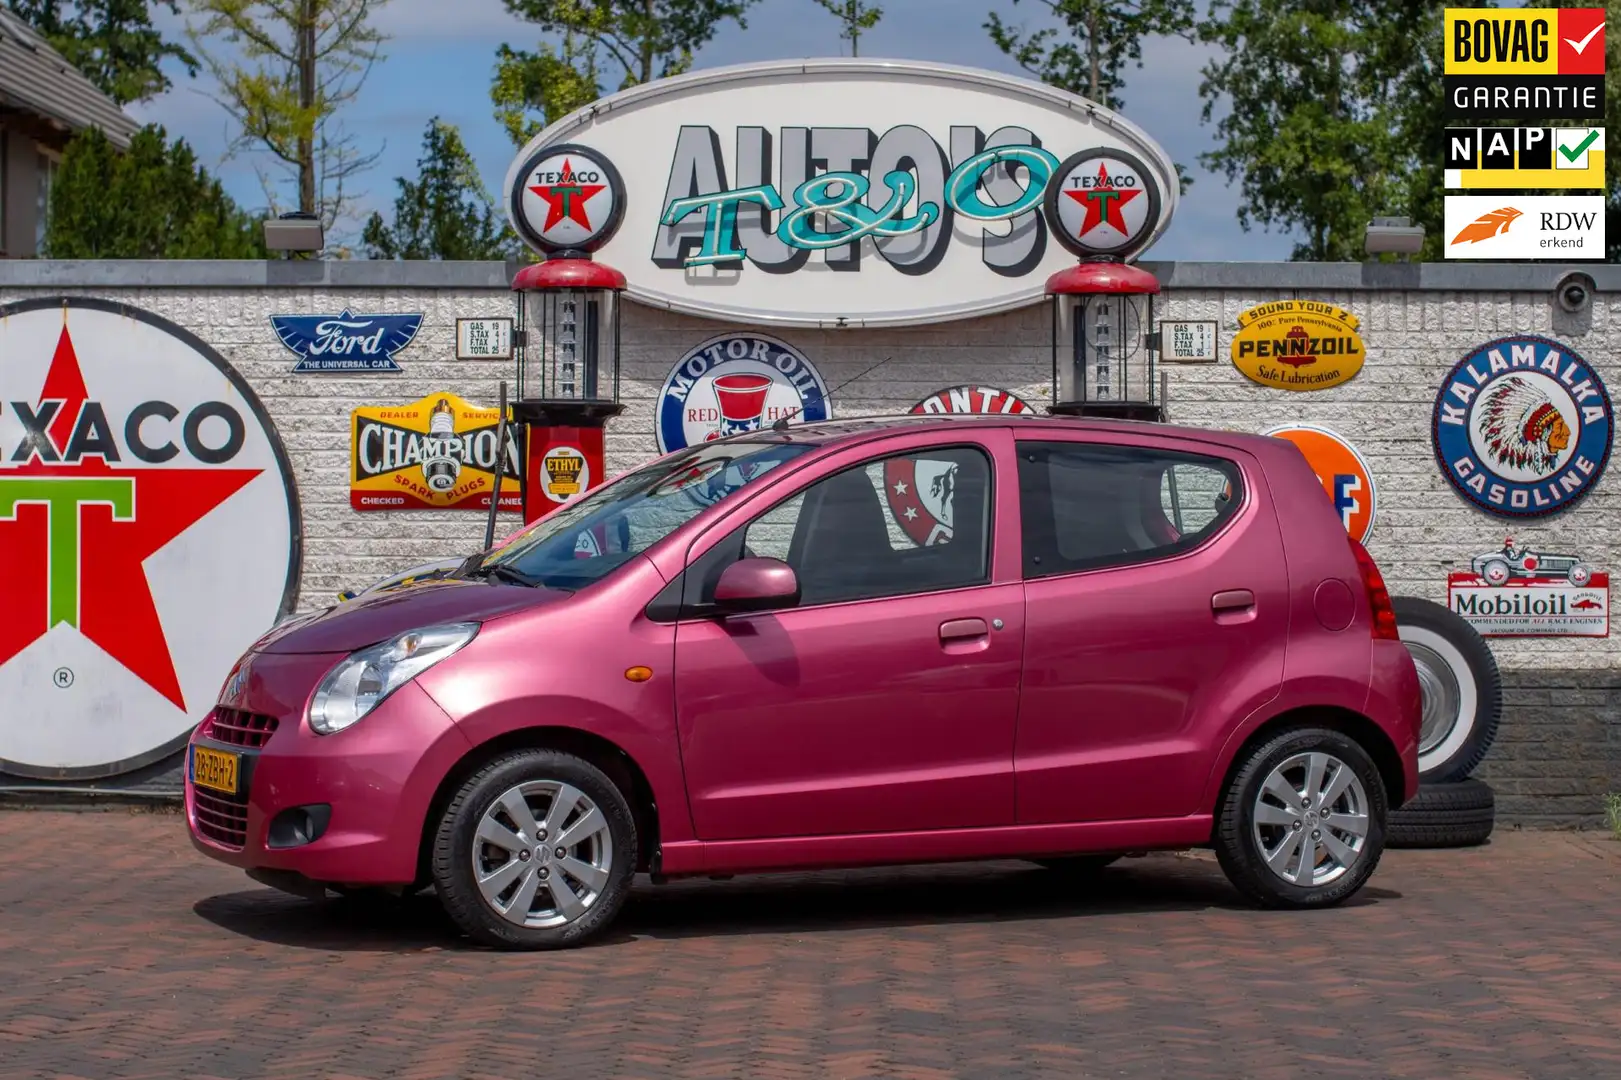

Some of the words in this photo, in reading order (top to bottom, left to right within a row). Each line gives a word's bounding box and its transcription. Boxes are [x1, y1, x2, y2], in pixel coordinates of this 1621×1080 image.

[535, 171, 599, 184] TEXACO
[1071, 176, 1136, 188] TEXACO
[651, 124, 1047, 277] AUTO'S
[1249, 302, 1293, 320] SOUND
[1298, 302, 1333, 315] YOUR
[1338, 310, 1349, 321] Z
[470, 322, 484, 330] GAS
[1174, 324, 1188, 332] GAS
[1196, 324, 1204, 332] 19
[1297, 316, 1343, 332] Pennsylvania
[309, 320, 385, 355] Ford
[1174, 333, 1194, 341] S.TAX
[1174, 349, 1194, 357] TOTAL
[1239, 337, 1359, 358] PENNZOIL
[304, 361, 320, 369] THE
[322, 360, 370, 369] UNIVERSAL
[372, 360, 390, 368] CAR
[666, 339, 771, 403] MOTOR
[775, 353, 818, 400] OIL
[1256, 364, 1279, 381] Safe
[1281, 369, 1341, 384] Lubrication
[1441, 345, 1605, 425] KALAMALKA
[688, 408, 718, 422] RED
[768, 406, 799, 420] HAT
[0, 400, 246, 464] XACO
[547, 458, 580, 471] ETHYL
[393, 474, 435, 500] SPARK
[446, 477, 486, 501] PLUGS
[1453, 455, 1595, 508] GASOLINE
[360, 497, 405, 505] CHECKED
[1455, 593, 1567, 615] Mobiloil
[196, 752, 234, 786] 28-ZBH-2
